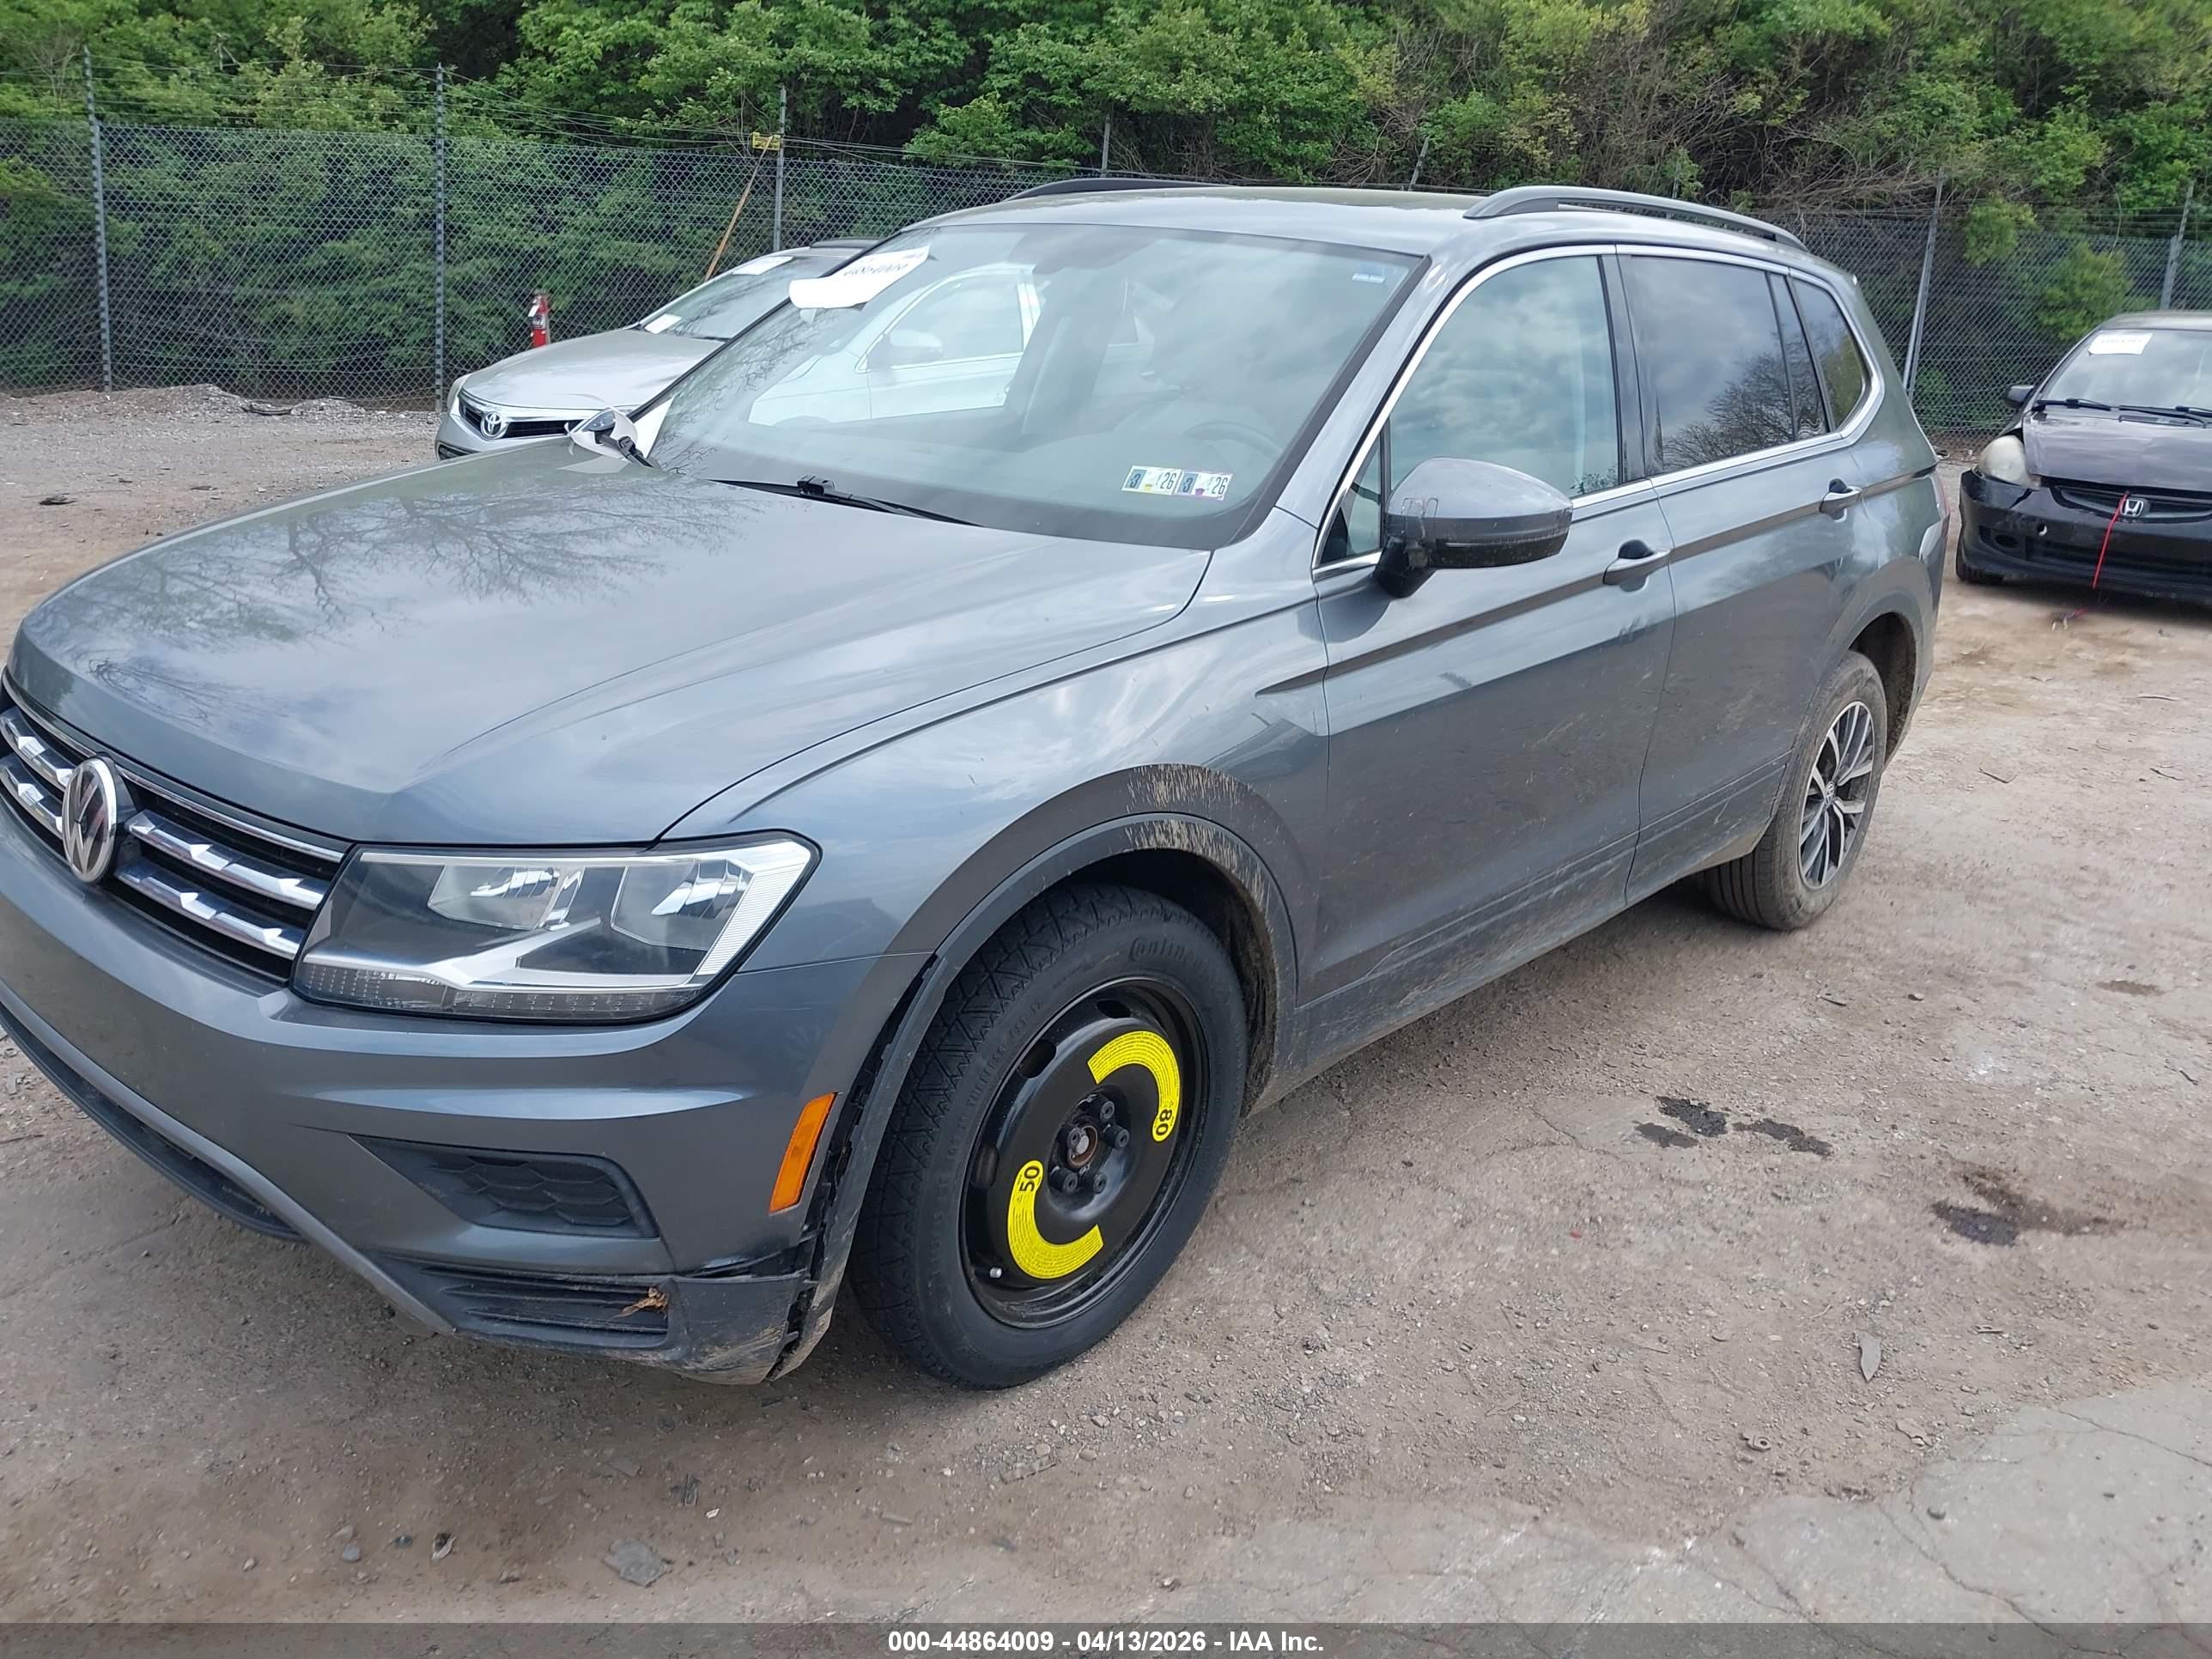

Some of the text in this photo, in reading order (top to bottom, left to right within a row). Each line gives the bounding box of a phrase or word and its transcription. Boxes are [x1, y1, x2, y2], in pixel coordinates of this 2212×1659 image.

[1160, 472, 1176, 489] 26
[1212, 477, 1228, 495] 26
[1155, 1105, 1174, 1137] 80
[1018, 1164, 1041, 1192] 50
